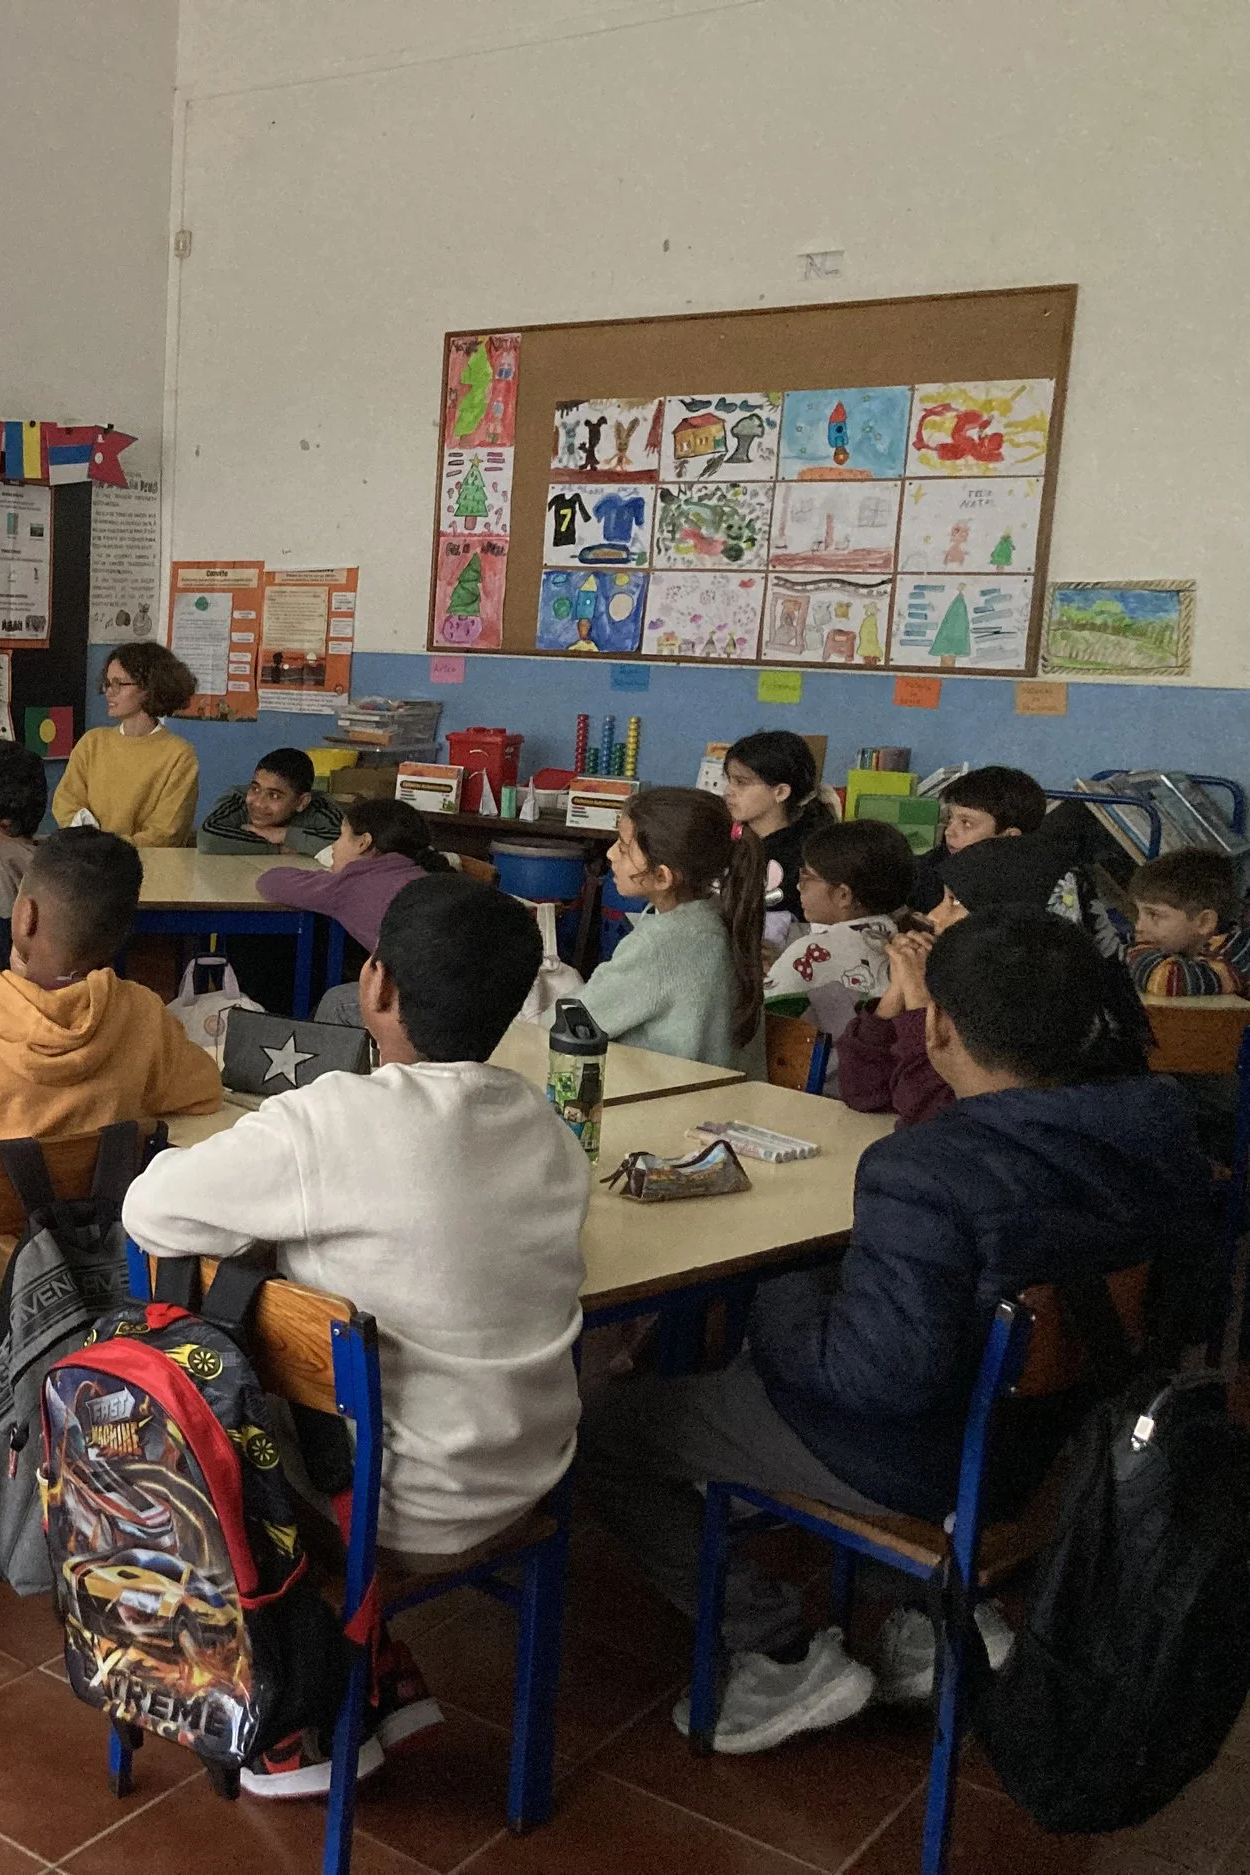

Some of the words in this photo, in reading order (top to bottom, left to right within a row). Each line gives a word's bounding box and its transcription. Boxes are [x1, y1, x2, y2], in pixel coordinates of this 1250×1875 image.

[560, 508, 572, 532] 7
[92, 1390, 130, 1424] FAST
[90, 1420, 140, 1454] MACHINE
[82, 1649, 230, 1740] EXTREME
